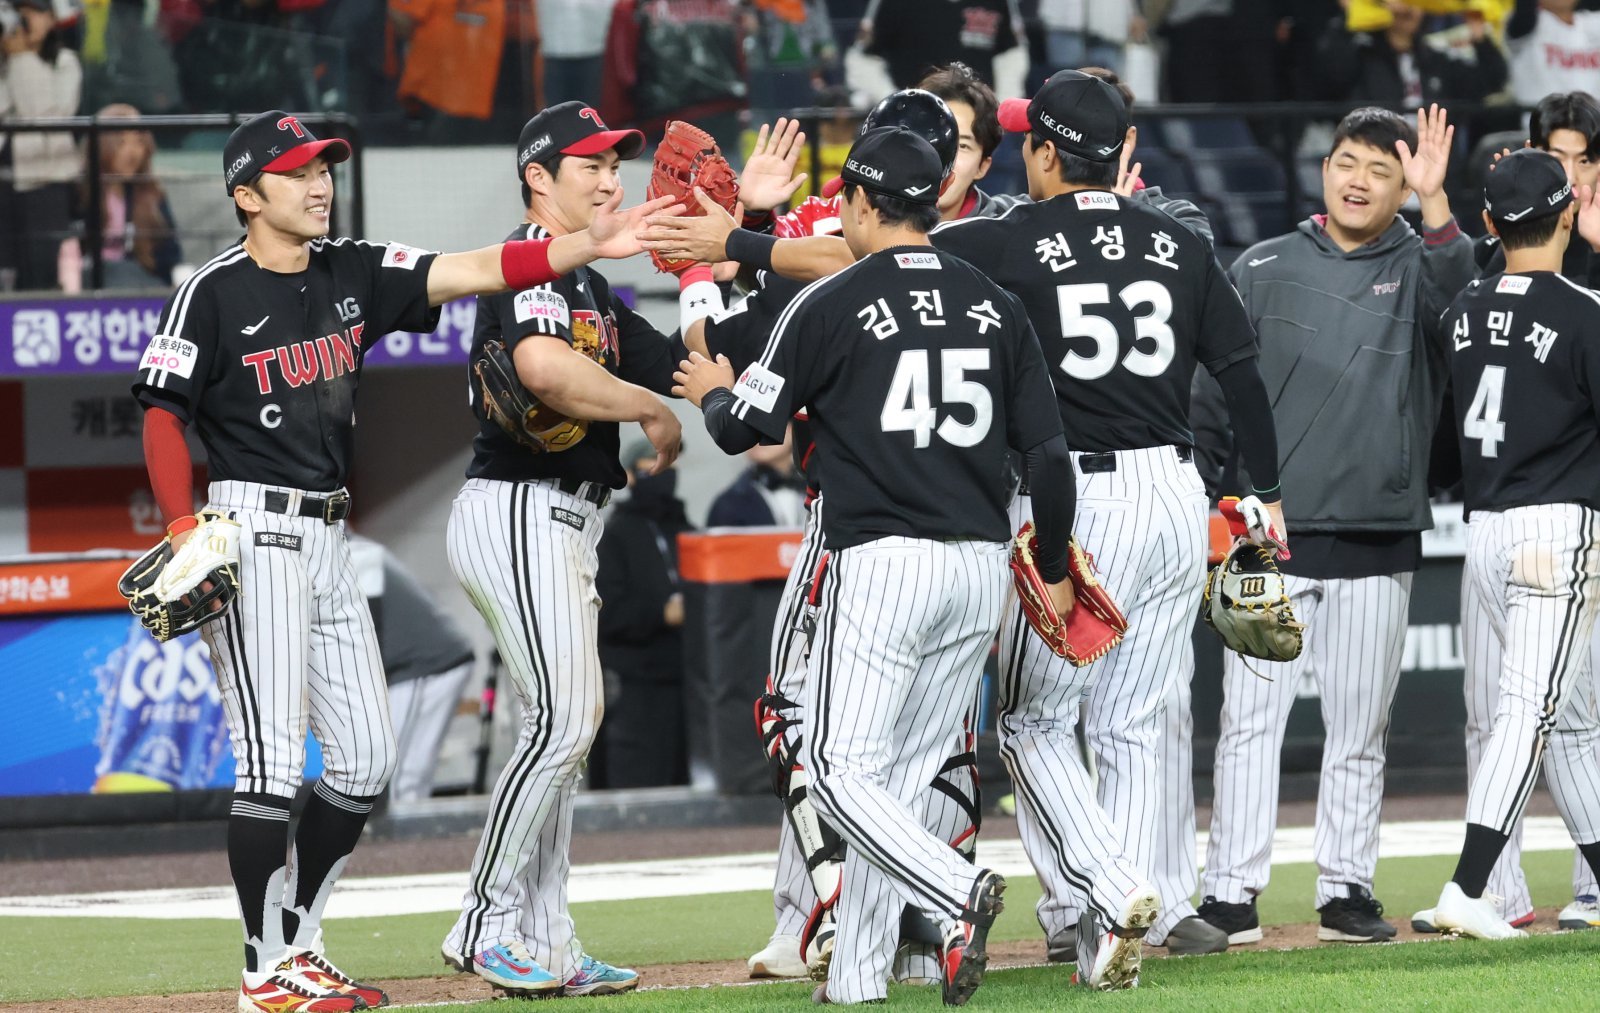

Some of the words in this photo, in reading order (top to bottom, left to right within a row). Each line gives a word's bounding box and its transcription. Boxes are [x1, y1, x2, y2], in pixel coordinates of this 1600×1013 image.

[1039, 111, 1083, 144] LGE.COM
[519, 135, 551, 166] LGE.COM
[846, 158, 884, 182] LGE.COM
[334, 297, 361, 323] LG
[520, 293, 533, 304] AI
[64, 307, 162, 366] 정한
[1057, 279, 1176, 381] 53
[159, 338, 193, 357] 통화앱
[880, 348, 993, 449] 45
[1463, 364, 1507, 459] 4
[260, 403, 282, 429] C
[260, 534, 277, 544] 영진
